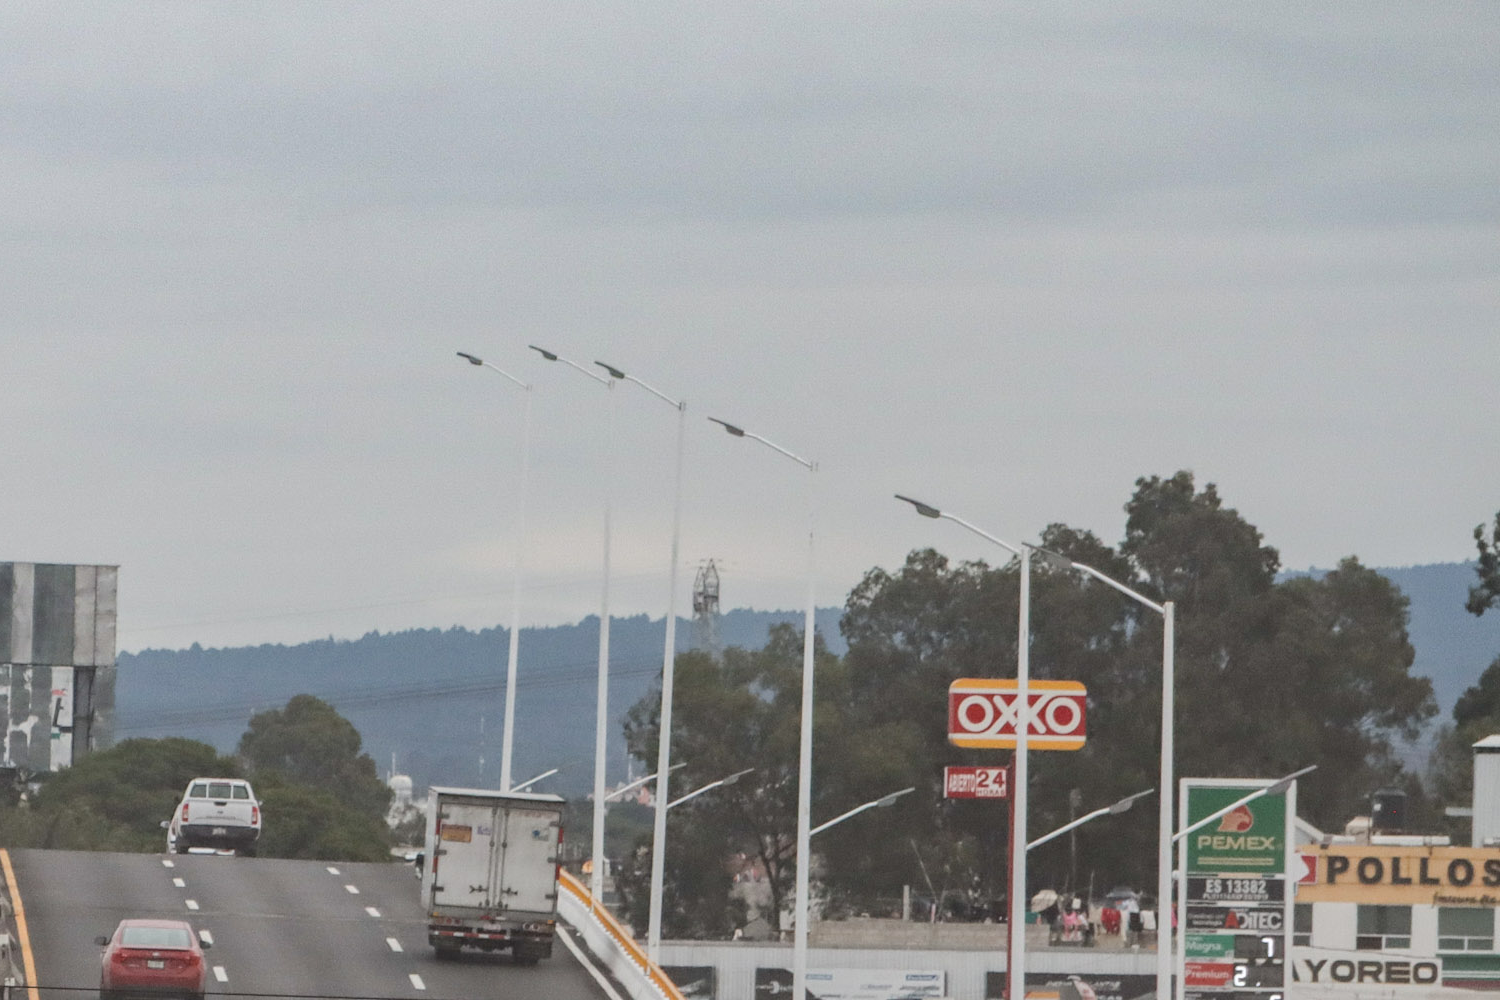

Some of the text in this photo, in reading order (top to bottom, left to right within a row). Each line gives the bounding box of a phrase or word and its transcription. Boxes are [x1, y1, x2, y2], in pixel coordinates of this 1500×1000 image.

[957, 694, 1082, 735] OXXO
[977, 771, 1004, 788] 24
[1198, 836, 1275, 850] PEMEX
[1326, 855, 1500, 887] POLLOS
[1206, 880, 1267, 894] ES 13382
[1185, 942, 1222, 954] Magna
[1261, 937, 1274, 957] 7
[1185, 970, 1230, 979] Premium
